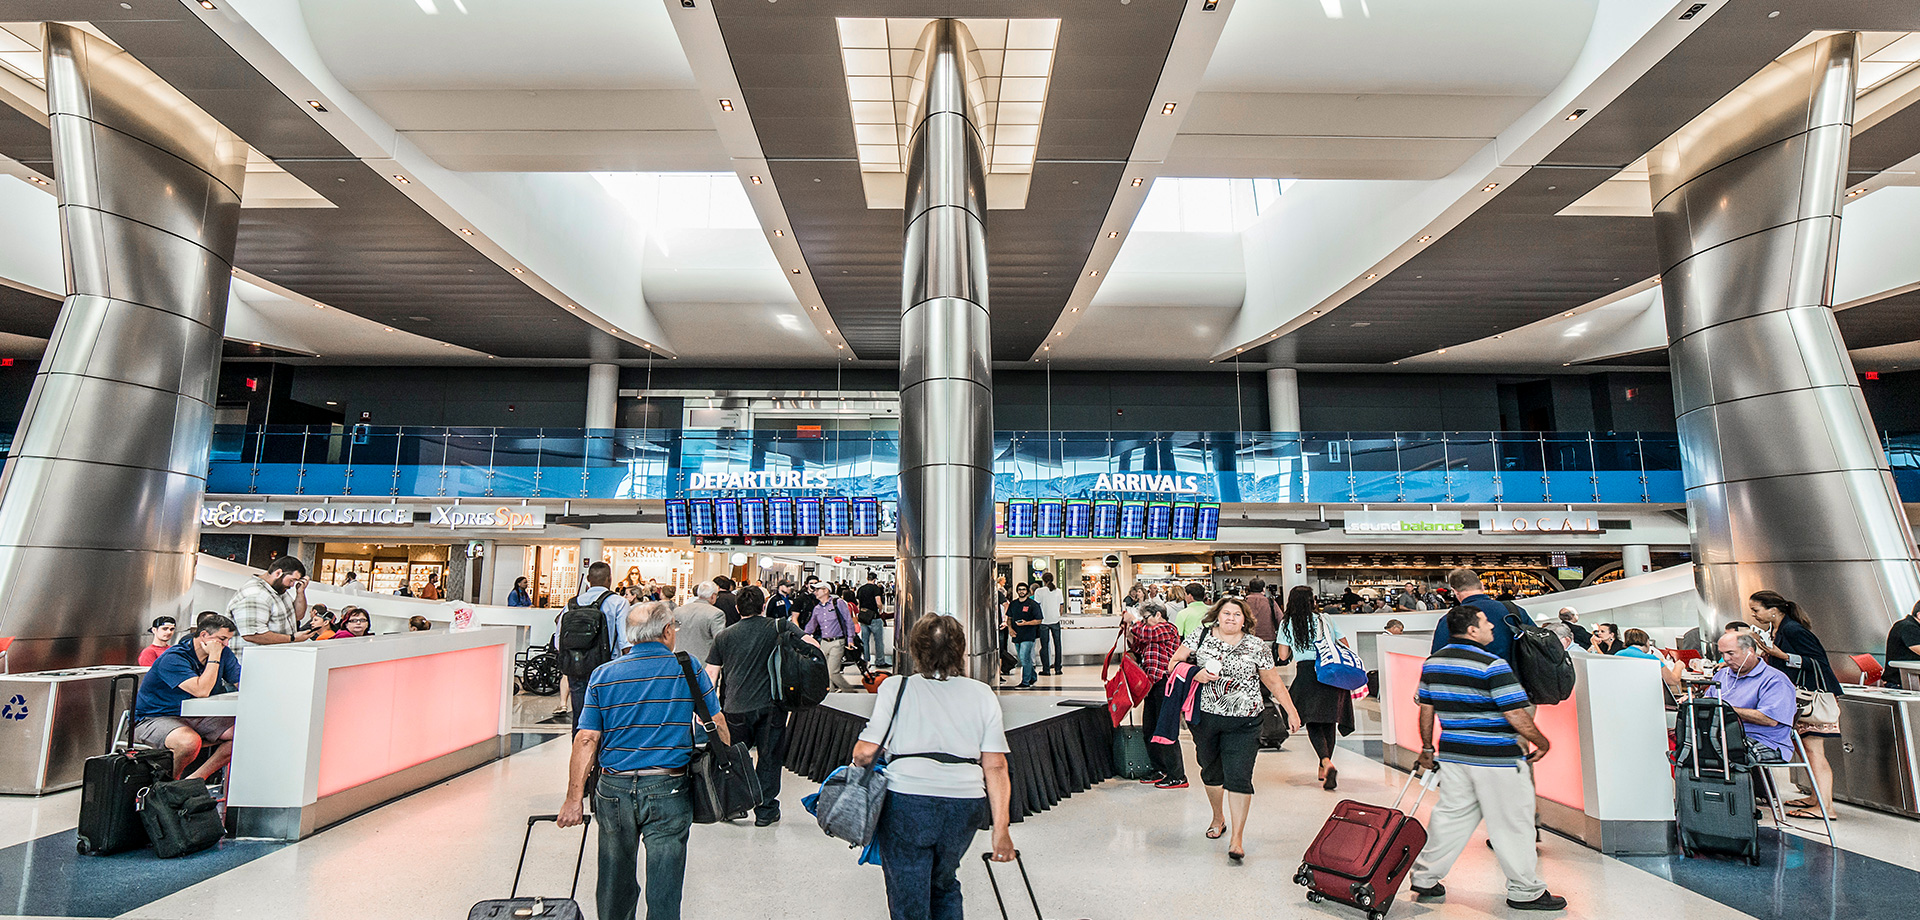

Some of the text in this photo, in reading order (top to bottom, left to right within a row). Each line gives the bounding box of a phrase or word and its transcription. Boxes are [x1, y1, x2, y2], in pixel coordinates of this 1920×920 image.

[690, 470, 829, 489] DEPARTURES
[1095, 473, 1198, 492] ARRIVALS
[297, 507, 407, 524] SOLSTICE
[1350, 521, 1464, 531] soundbalance
[1490, 517, 1598, 532] LOCAL
